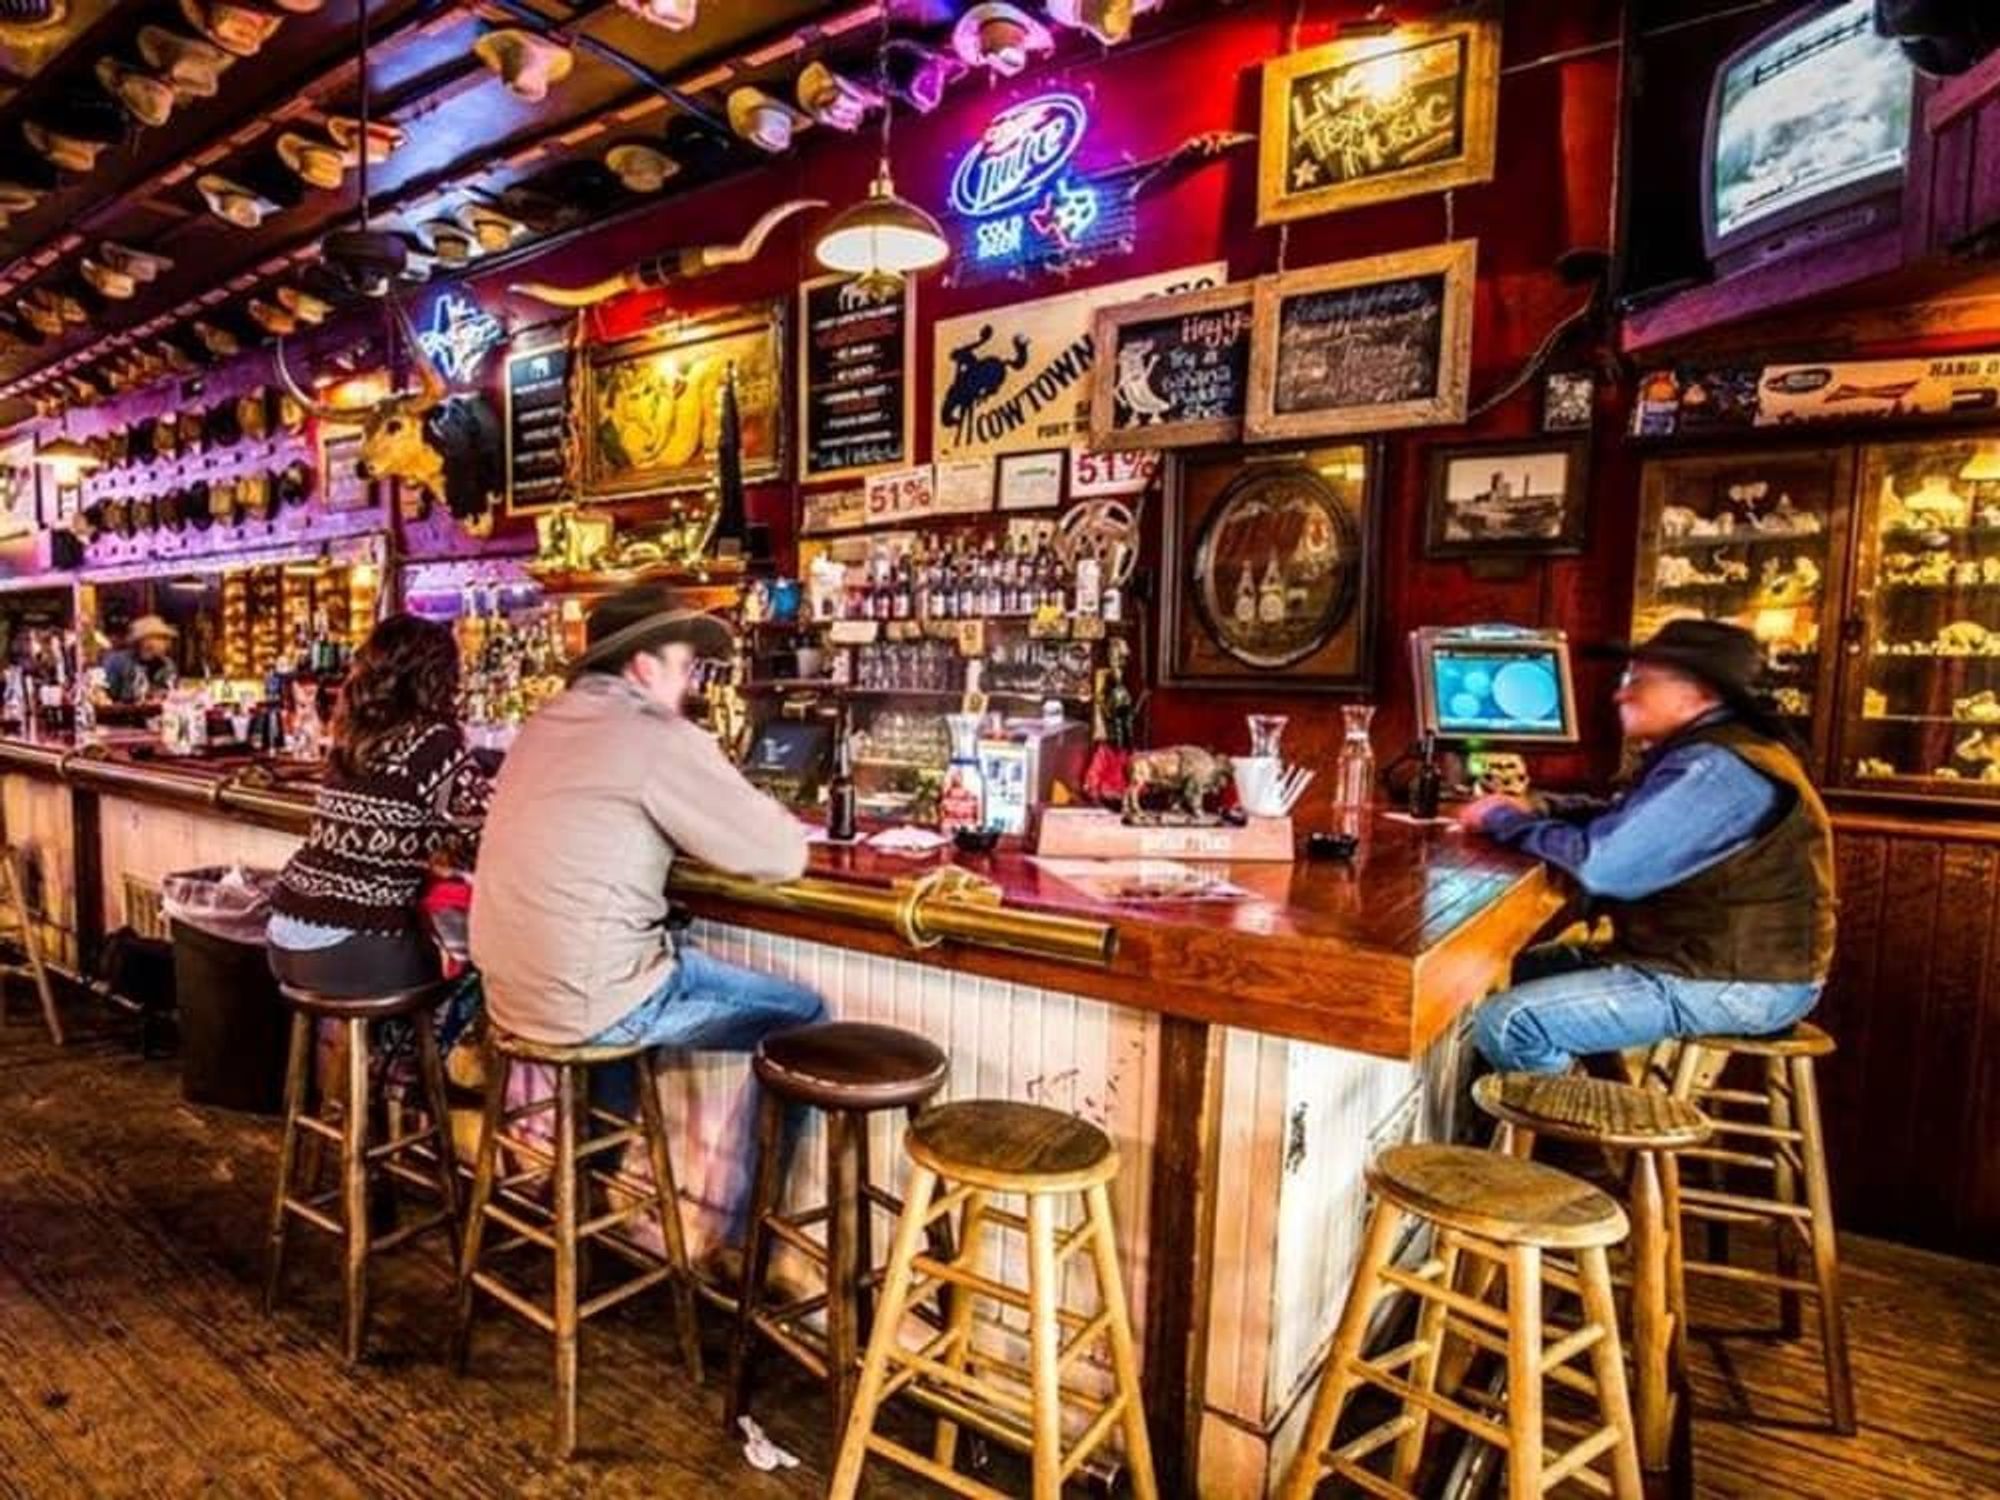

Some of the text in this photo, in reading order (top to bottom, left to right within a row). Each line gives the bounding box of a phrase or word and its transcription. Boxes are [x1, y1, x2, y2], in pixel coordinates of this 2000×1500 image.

[975, 333, 1096, 445] COWTOWN
[1075, 448, 1157, 486] 51%
[868, 478, 931, 514] 51%
